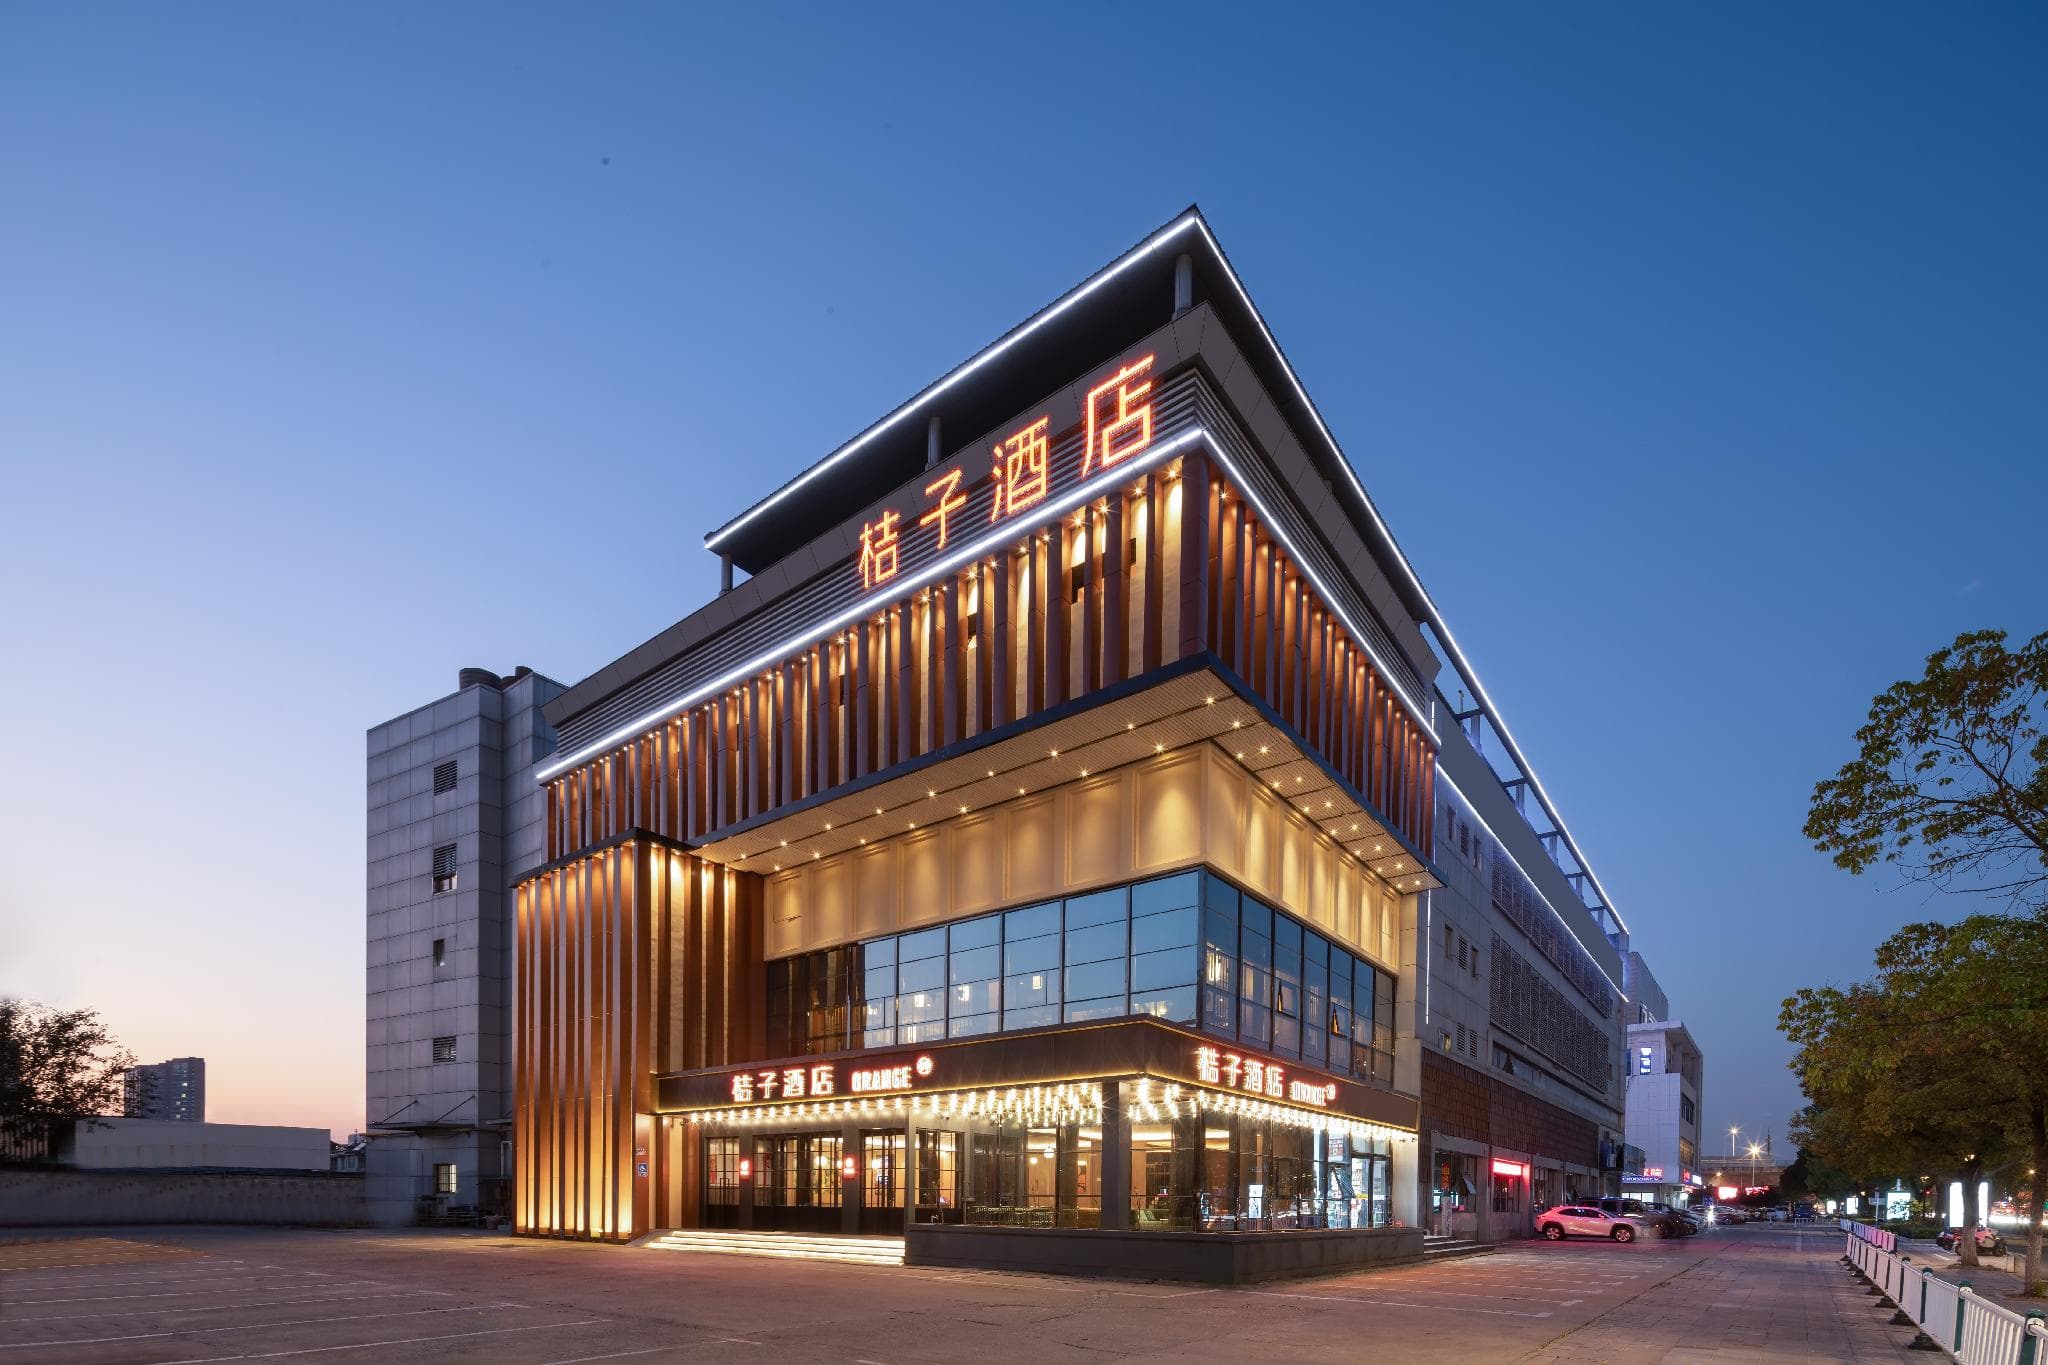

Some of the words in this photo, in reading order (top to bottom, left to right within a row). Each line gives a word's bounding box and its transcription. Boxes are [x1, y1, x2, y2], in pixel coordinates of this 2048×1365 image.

[858, 353, 1156, 589] 桔子酒店
[732, 1065, 834, 1102] 桔子酒店
[851, 1066, 912, 1092] ORANGE
[1197, 1046, 1284, 1098] 桔子酒店
